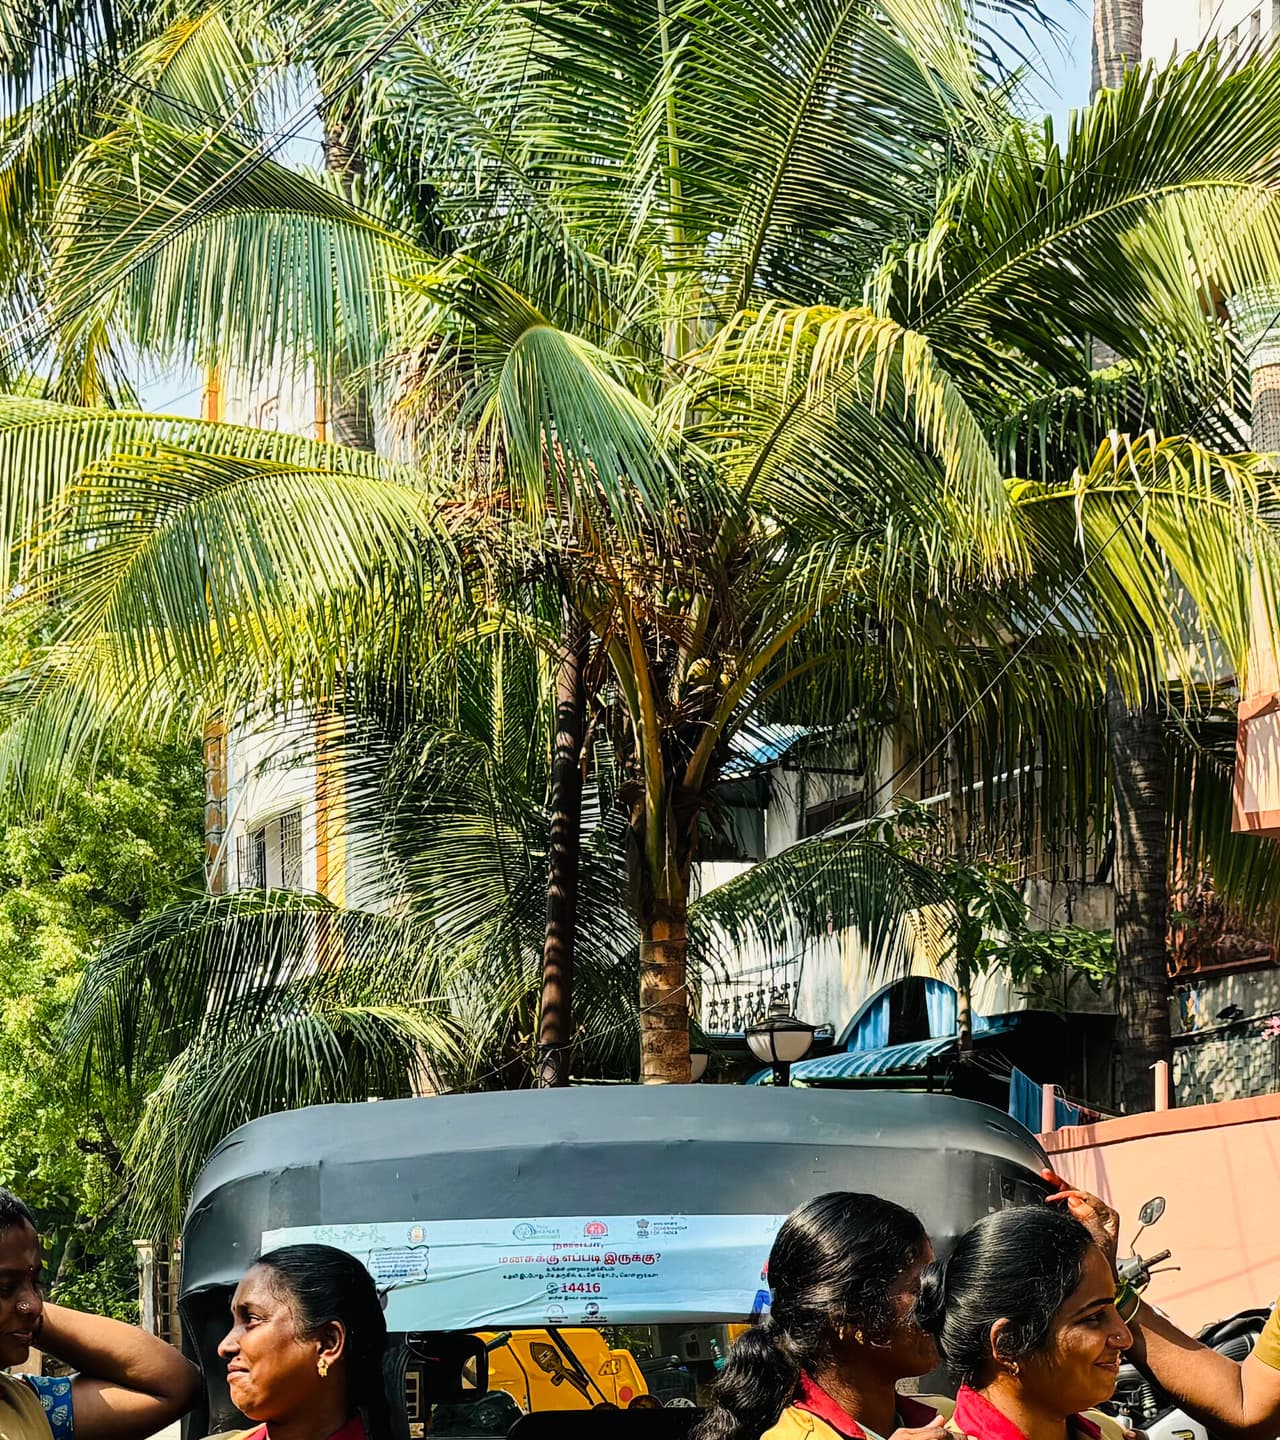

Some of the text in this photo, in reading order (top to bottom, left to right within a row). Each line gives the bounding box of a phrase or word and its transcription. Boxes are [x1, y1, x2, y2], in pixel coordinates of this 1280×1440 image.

[562, 1253, 600, 1264] எப்படி
[604, 1252, 661, 1265] இருக்கு?
[561, 1282, 601, 1293] 14416
